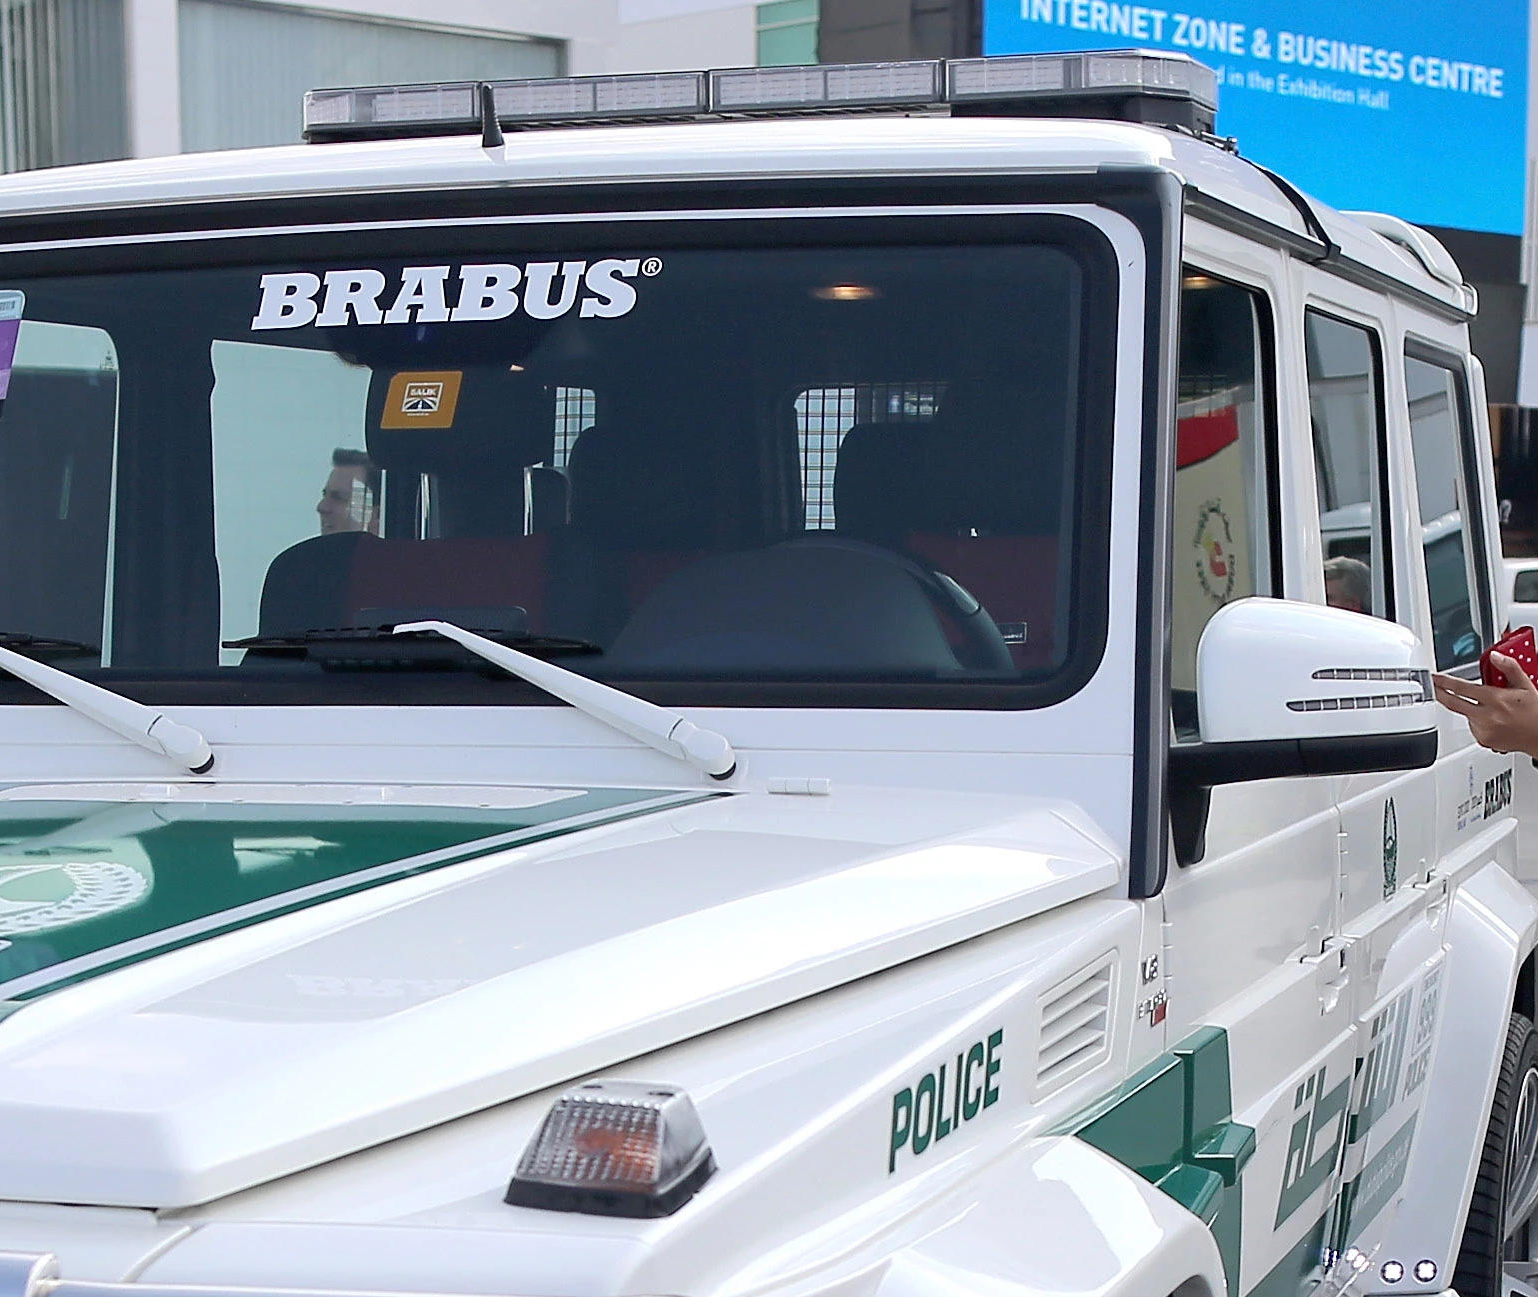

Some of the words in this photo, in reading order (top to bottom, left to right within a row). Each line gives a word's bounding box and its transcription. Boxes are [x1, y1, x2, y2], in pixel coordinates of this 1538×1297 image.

[1019, 0, 1168, 42] INTERNET
[1171, 13, 1246, 56] ZONE
[1251, 27, 1273, 60] &
[1277, 31, 1404, 82] BUSINESS
[1408, 55, 1505, 98] CENTRE
[1227, 69, 1245, 85] in
[1247, 71, 1275, 93] the
[1276, 73, 1356, 104] Exhibition
[1356, 87, 1390, 111] Hall
[1484, 768, 1512, 820] BRABUS
[889, 1030, 1003, 1174] POLICE
